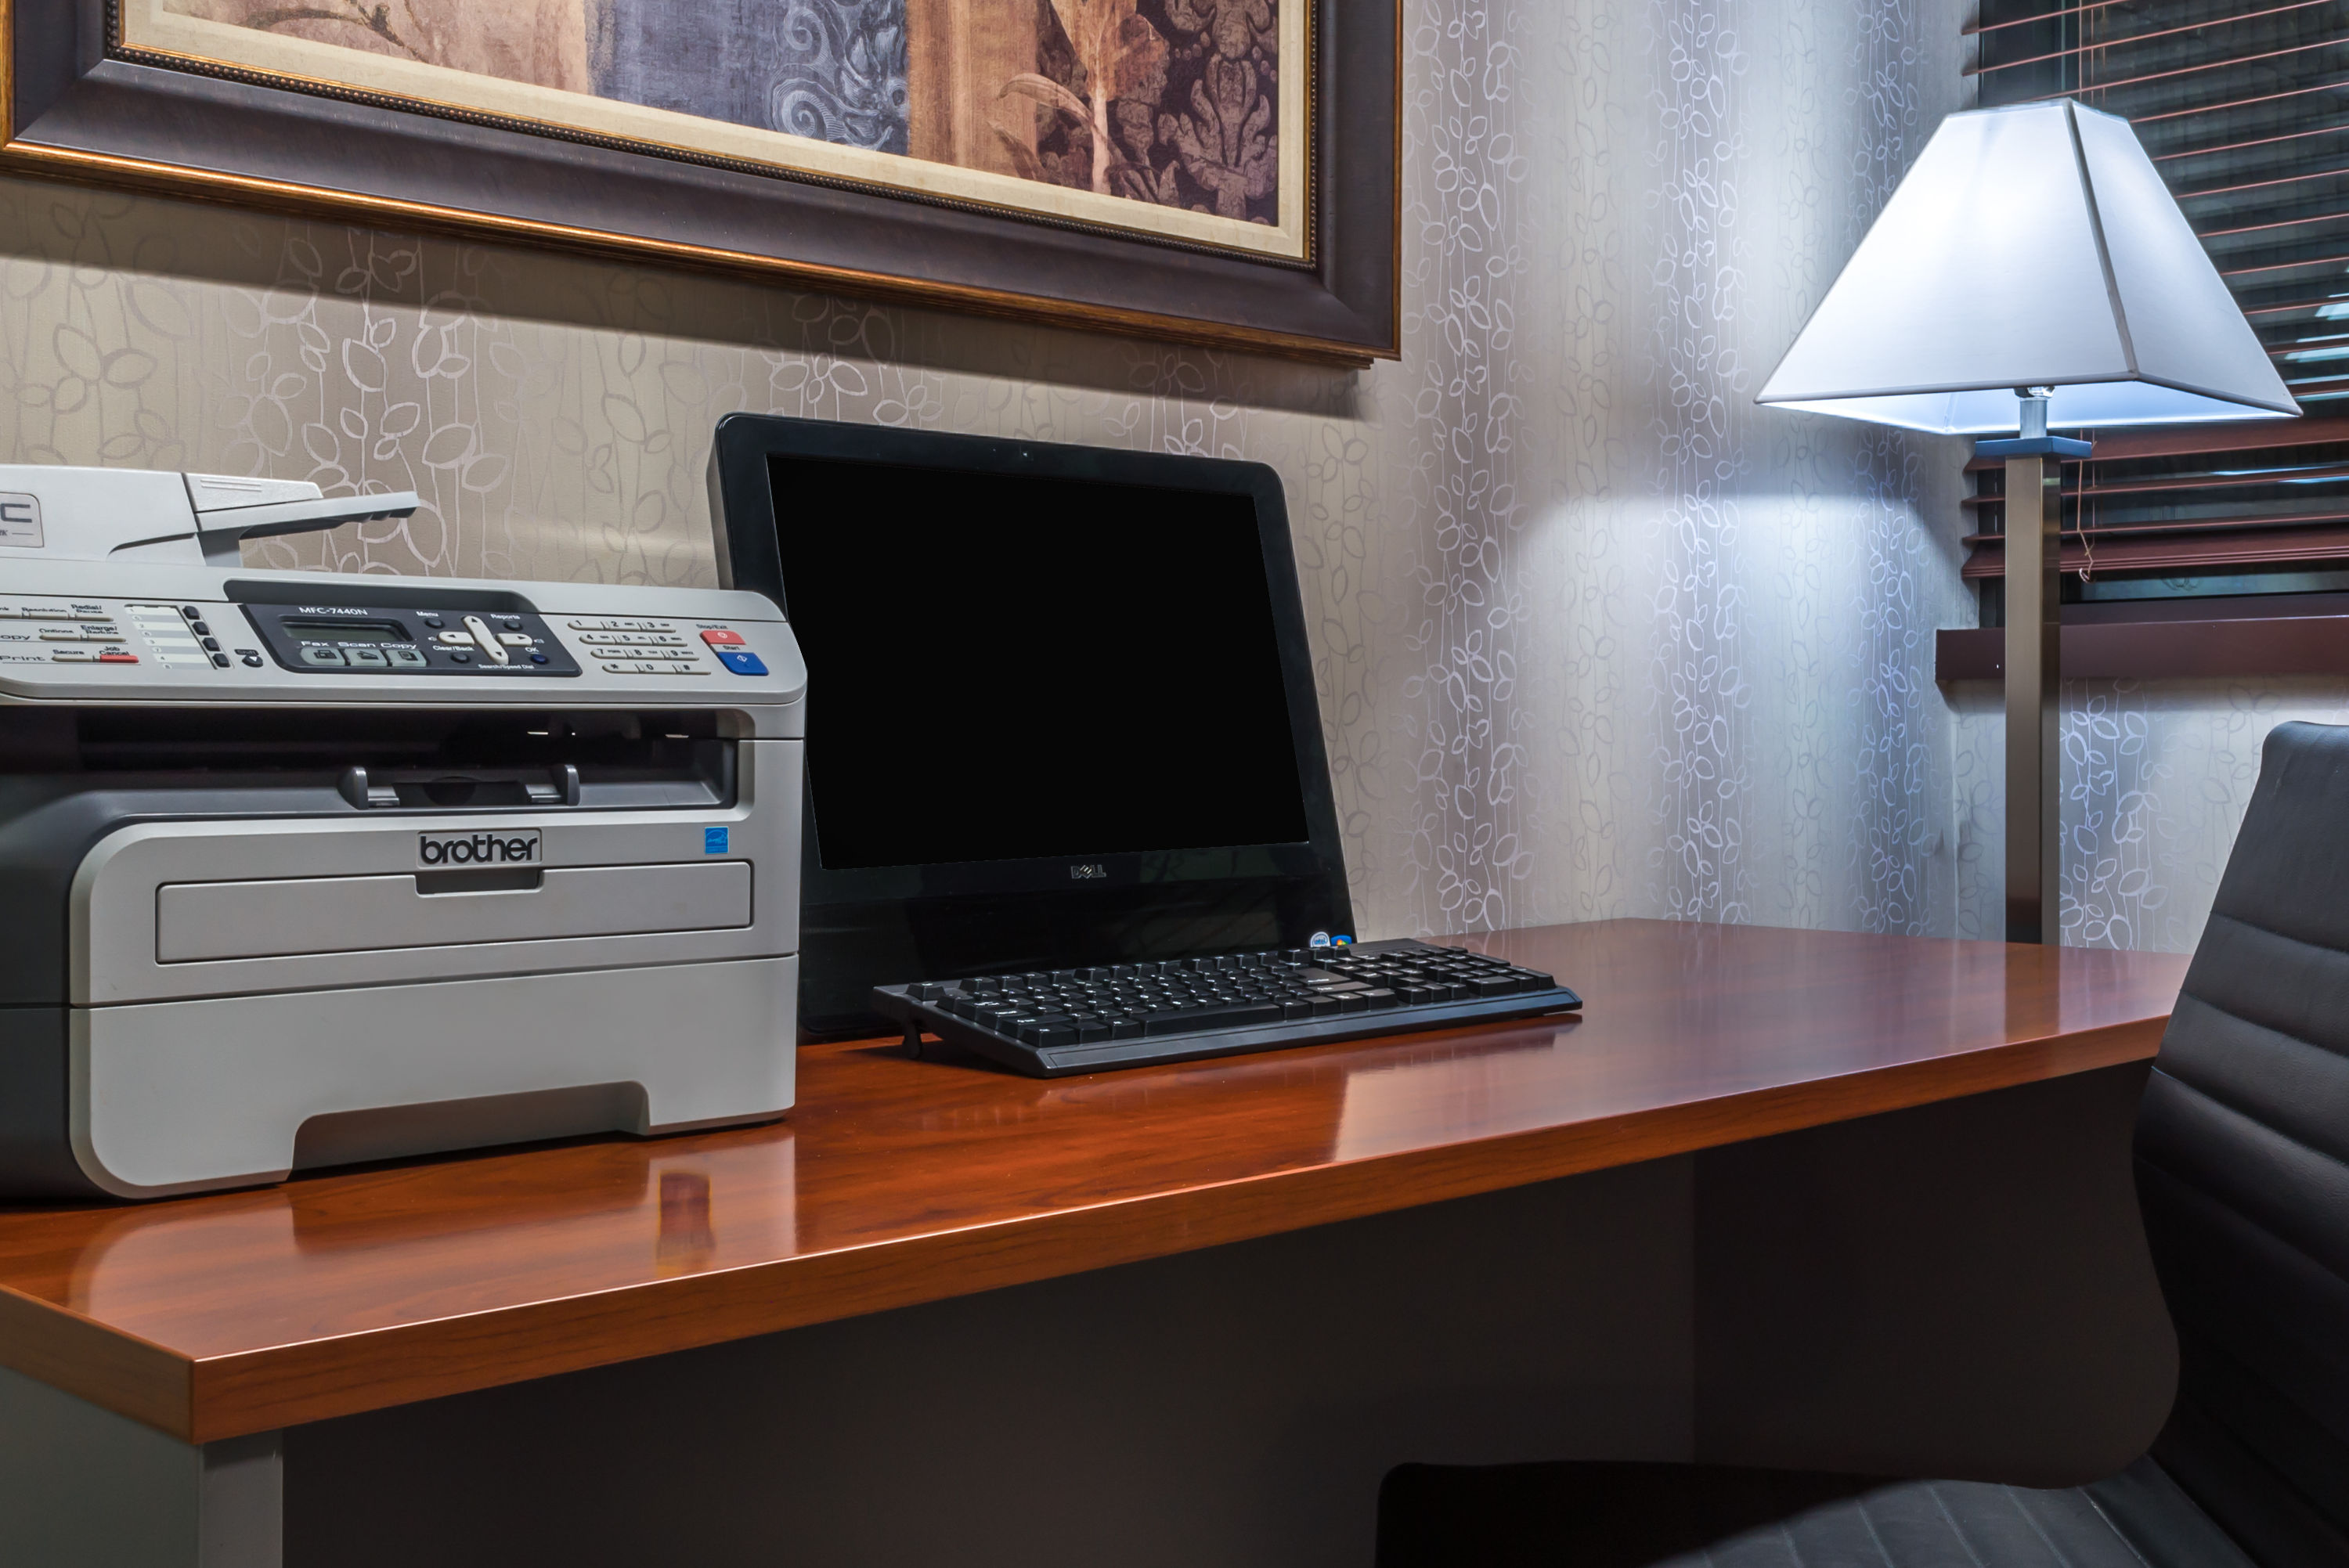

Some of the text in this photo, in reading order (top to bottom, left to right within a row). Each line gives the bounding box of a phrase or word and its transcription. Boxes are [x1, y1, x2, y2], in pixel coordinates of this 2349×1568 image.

[298, 607, 368, 615] MFC-7440N
[420, 834, 538, 863] brother
[1070, 864, 1107, 879] DELL
